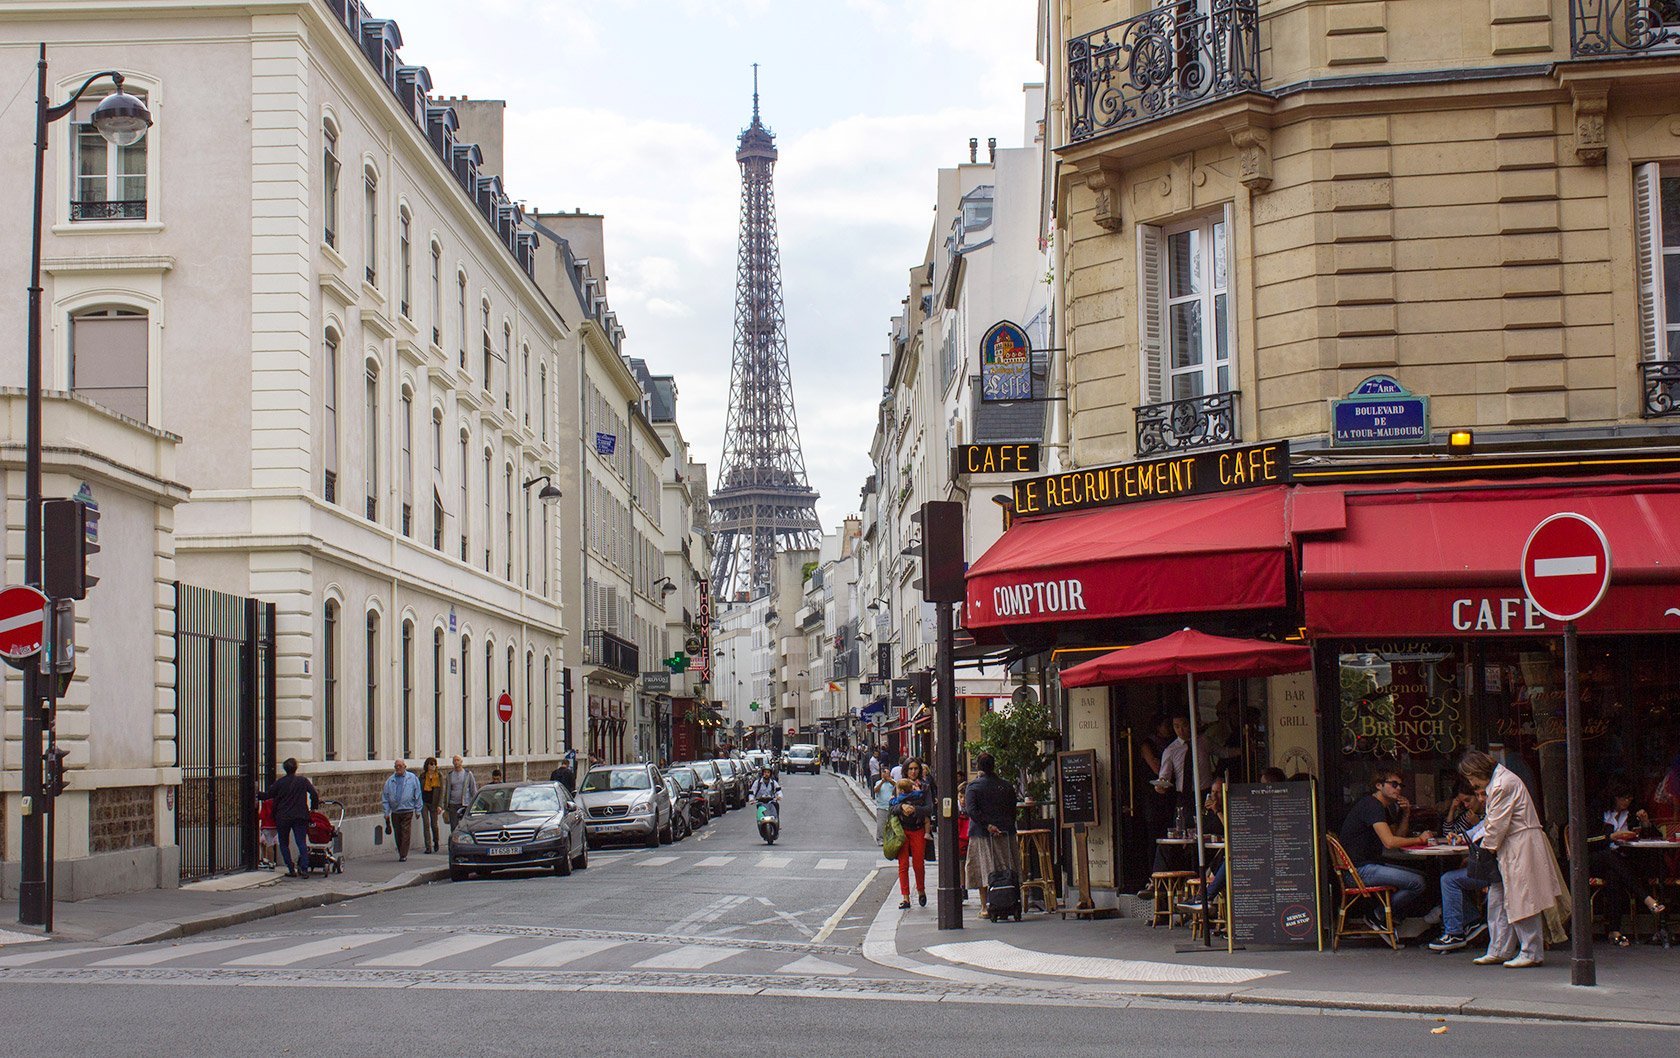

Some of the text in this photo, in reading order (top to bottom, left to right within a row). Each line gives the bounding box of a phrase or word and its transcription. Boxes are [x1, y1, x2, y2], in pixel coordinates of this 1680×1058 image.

[985, 374, 1030, 396] Leffe
[1355, 405, 1405, 416] BOULEVARD
[1374, 417, 1387, 426] DE
[1337, 426, 1424, 439] LA TOUR-MAUBOURG
[967, 445, 1030, 472] CAFE
[1015, 446, 1277, 514] LE RECRUTEMENT CAFE
[993, 579, 1087, 617] COMPTOIR
[1452, 598, 1546, 631] CAFE
[1081, 697, 1096, 707] BAR
[1285, 690, 1305, 701] BAR
[1078, 720, 1099, 730] GRILL
[1280, 716, 1308, 727] GRILL
[1360, 715, 1445, 737] BRUNCH
